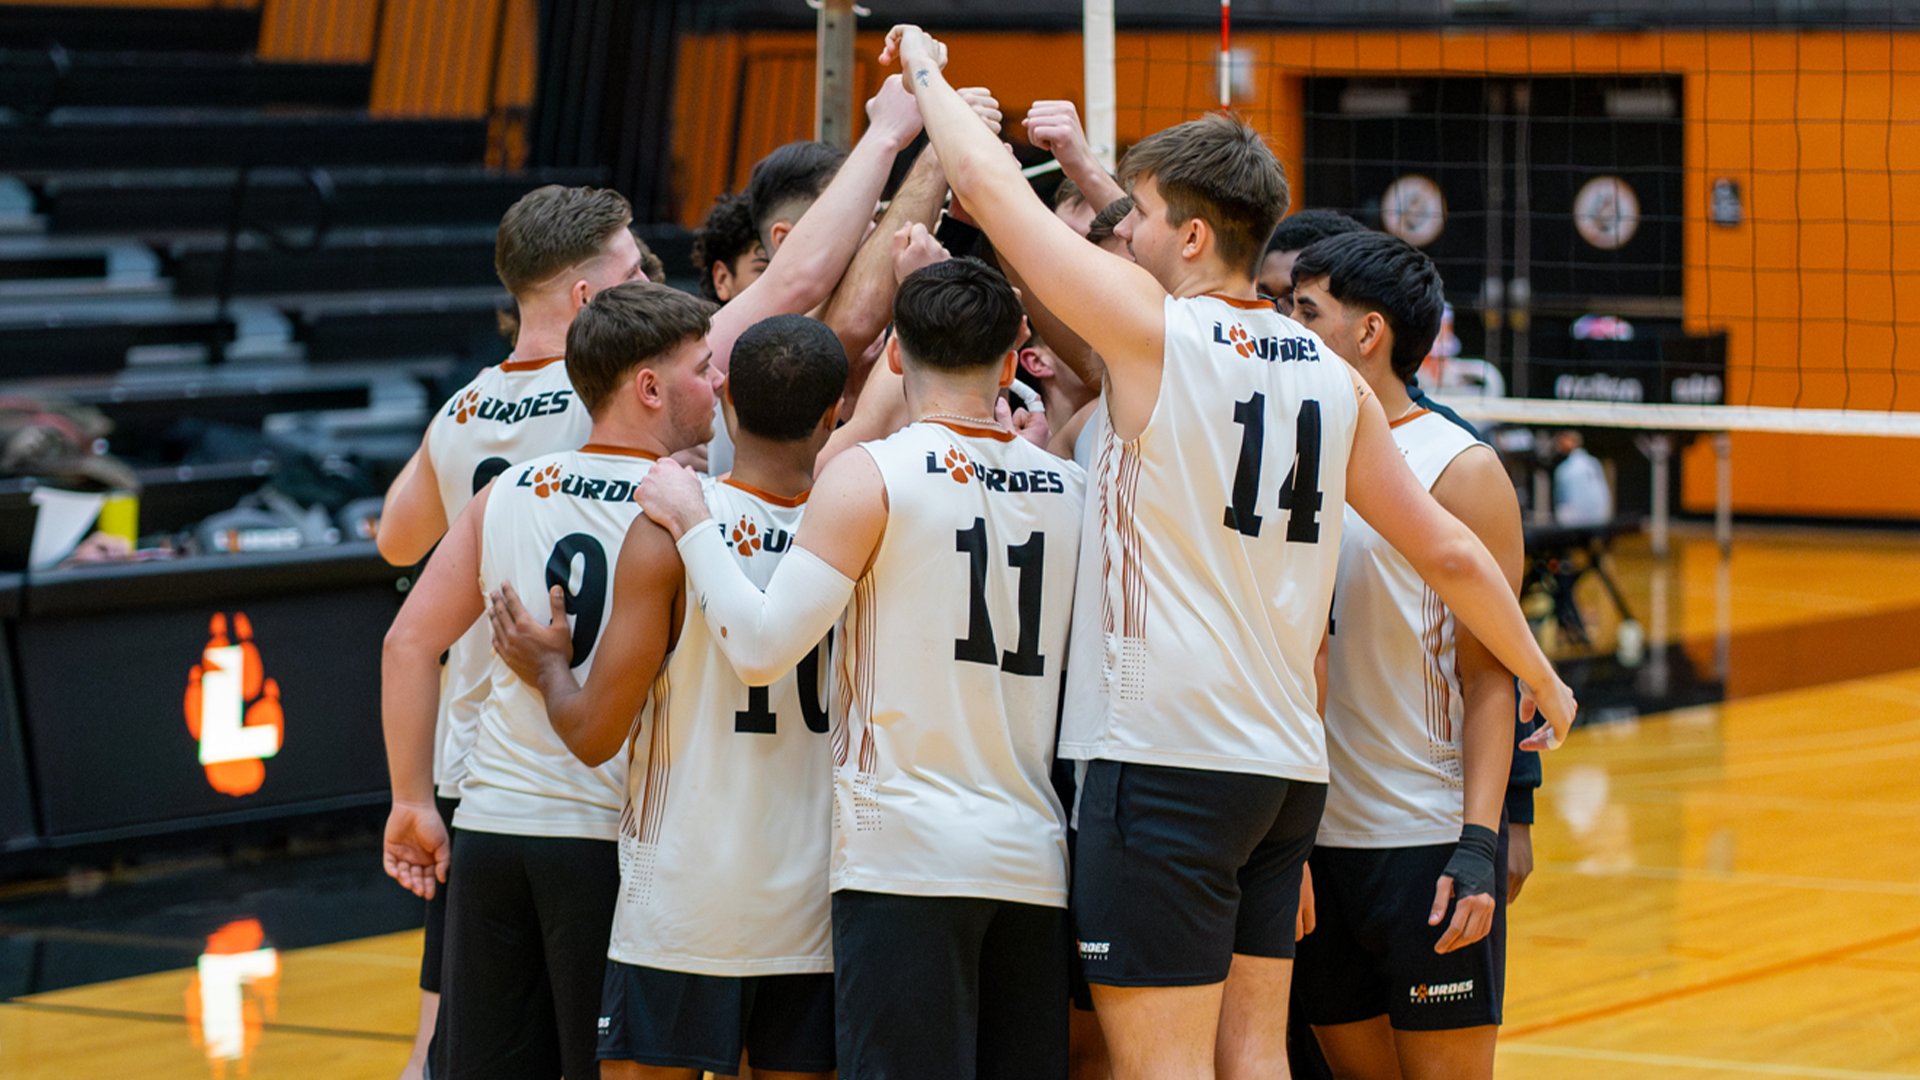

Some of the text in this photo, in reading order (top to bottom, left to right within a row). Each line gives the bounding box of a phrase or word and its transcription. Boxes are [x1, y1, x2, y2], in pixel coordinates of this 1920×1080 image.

[448, 387, 573, 424] LOURDES
[516, 462, 641, 502] LOURD
[926, 445, 1064, 494] LOURDES
[1223, 391, 1323, 543] 14
[545, 532, 608, 669] 9
[954, 517, 1044, 676] 11
[199, 645, 278, 765] L
[1410, 979, 1473, 998] LOURDES
